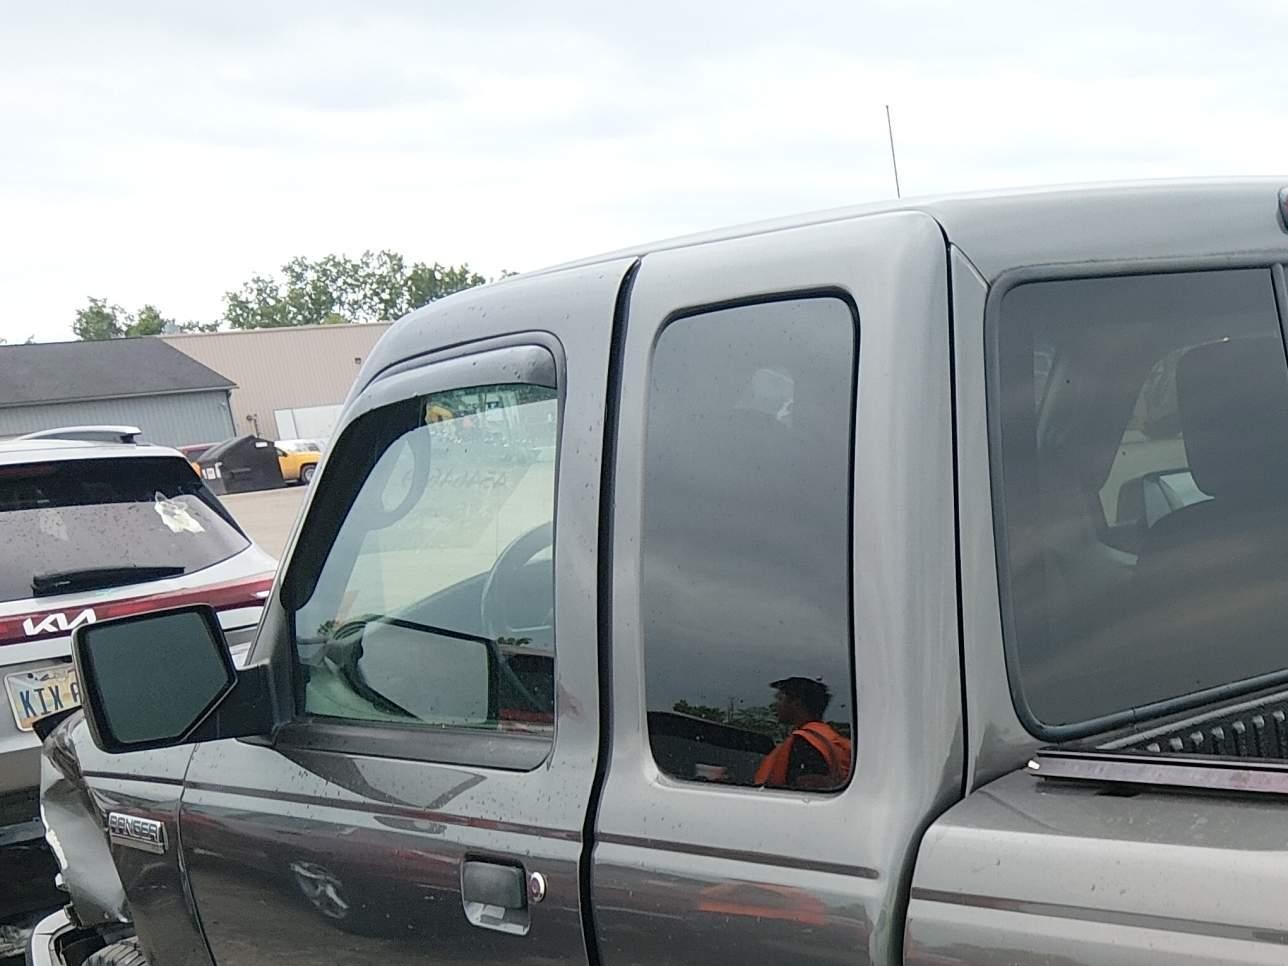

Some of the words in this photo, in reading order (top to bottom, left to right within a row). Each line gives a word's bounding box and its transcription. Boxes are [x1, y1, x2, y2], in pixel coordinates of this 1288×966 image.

[23, 608, 97, 635] KIA
[20, 685, 63, 718] KIX
[109, 814, 160, 842] RANGER
